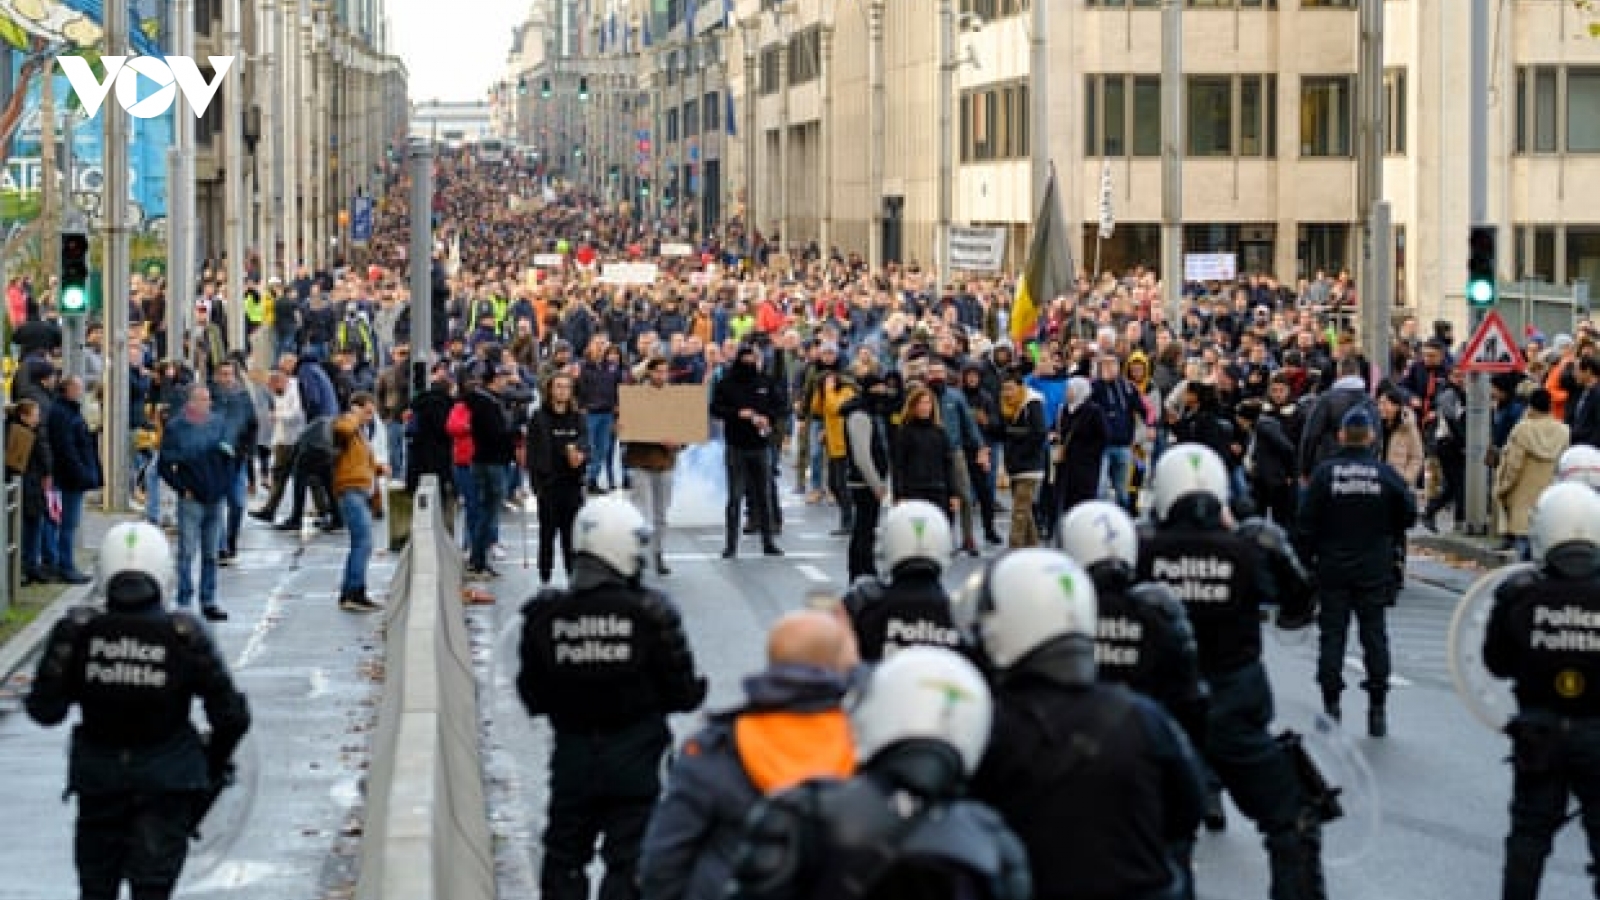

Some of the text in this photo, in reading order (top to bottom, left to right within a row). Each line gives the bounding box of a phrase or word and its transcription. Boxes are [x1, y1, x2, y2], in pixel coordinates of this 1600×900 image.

[1151, 555, 1232, 579] Politie
[1164, 580, 1229, 602] olice
[552, 614, 632, 639] Politie
[887, 618, 959, 646] Police
[90, 638, 166, 662] Police
[556, 641, 631, 664] Police
[1094, 642, 1138, 665] lice
[86, 662, 166, 686] Politie
